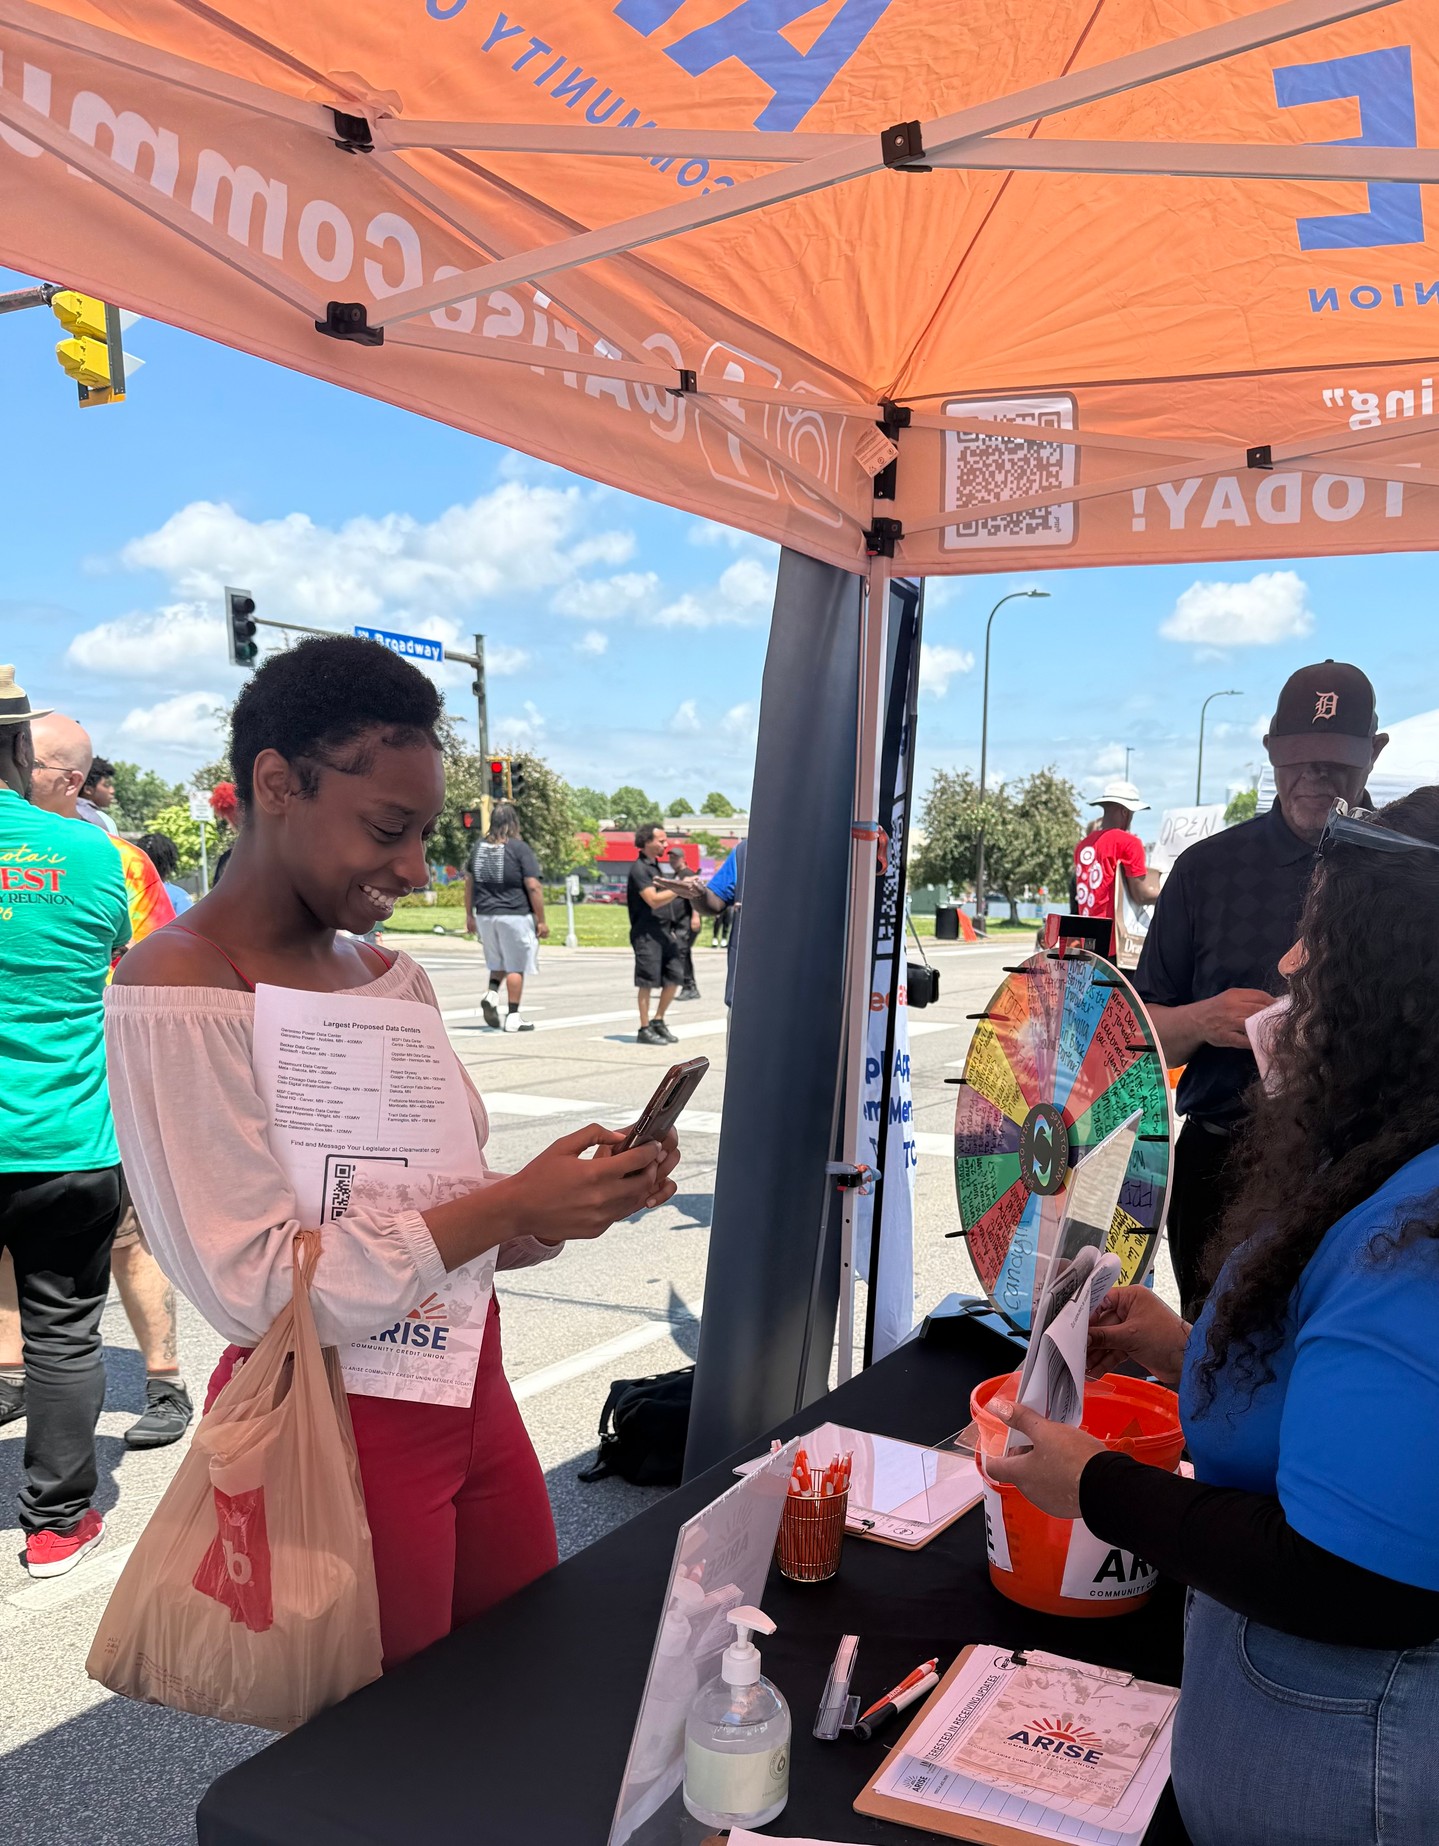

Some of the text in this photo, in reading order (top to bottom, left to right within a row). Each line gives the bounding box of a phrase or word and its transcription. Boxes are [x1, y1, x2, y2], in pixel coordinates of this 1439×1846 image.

[374, 632, 440, 662] Broadway
[1312, 691, 1339, 724] D
[1160, 813, 1220, 846] OPEN
[8, 893, 75, 907] REUNION
[324, 1020, 421, 1034] Largest Proposed Data Centers
[1020, 1121, 1030, 1144] WIN
[1050, 1111, 1064, 1135] SPIN
[290, 1139, 304, 1147] Find
[318, 1142, 346, 1151] Message
[362, 1145, 391, 1153] Legislator
[1022, 1165, 1034, 1188] SPIN
[1056, 1157, 1066, 1182] WIN
[370, 1321, 450, 1350] RISE
[351, 1342, 445, 1360] COMMUNITY CREDIT UNION
[1090, 1586, 1145, 1598] COMMUNITY
[953, 1697, 980, 1726] RECEIVING
[974, 1675, 998, 1701] UPDATES
[1003, 1741, 1096, 1770] COMMUNITY CREDIT UNION
[1007, 1730, 1104, 1765] ARISE
